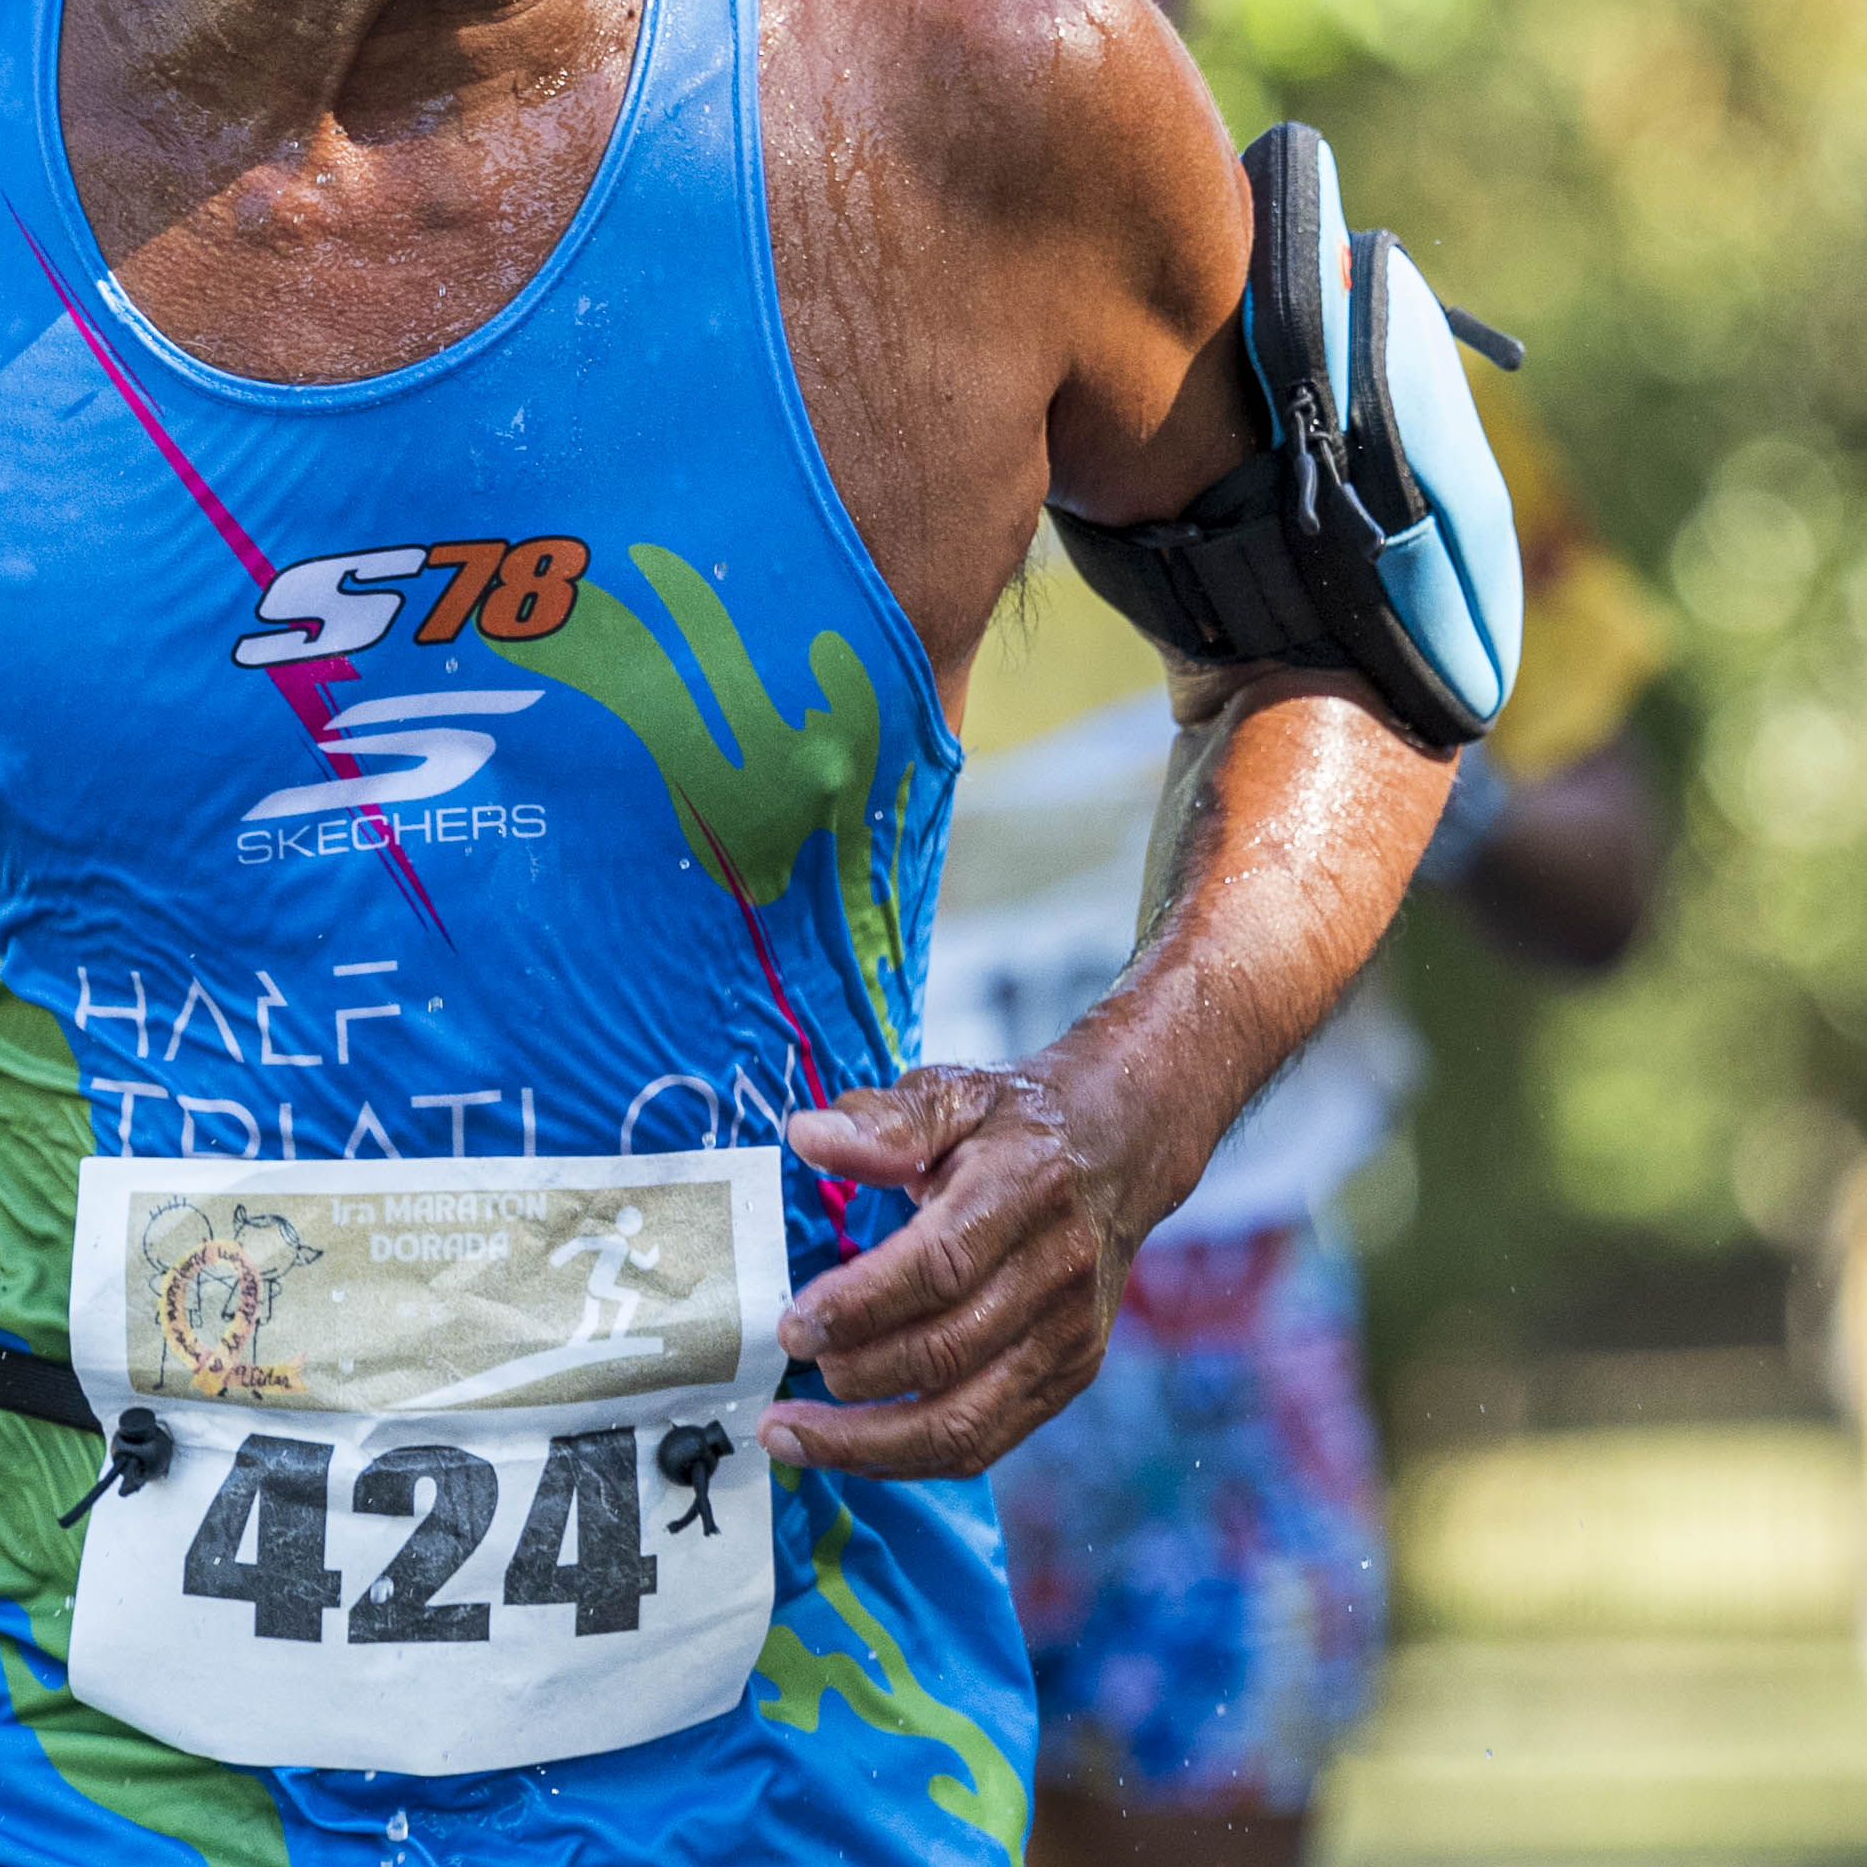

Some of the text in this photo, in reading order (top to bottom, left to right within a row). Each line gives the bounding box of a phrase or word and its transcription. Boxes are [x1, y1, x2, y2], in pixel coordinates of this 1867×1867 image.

[232, 535, 590, 669] S78
[236, 804, 547, 865] SKECHERS
[75, 959, 402, 1067] HALF
[369, 1230, 511, 1262] DORADA
[384, 1191, 548, 1224] MARATON
[182, 1424, 659, 1645] 424
